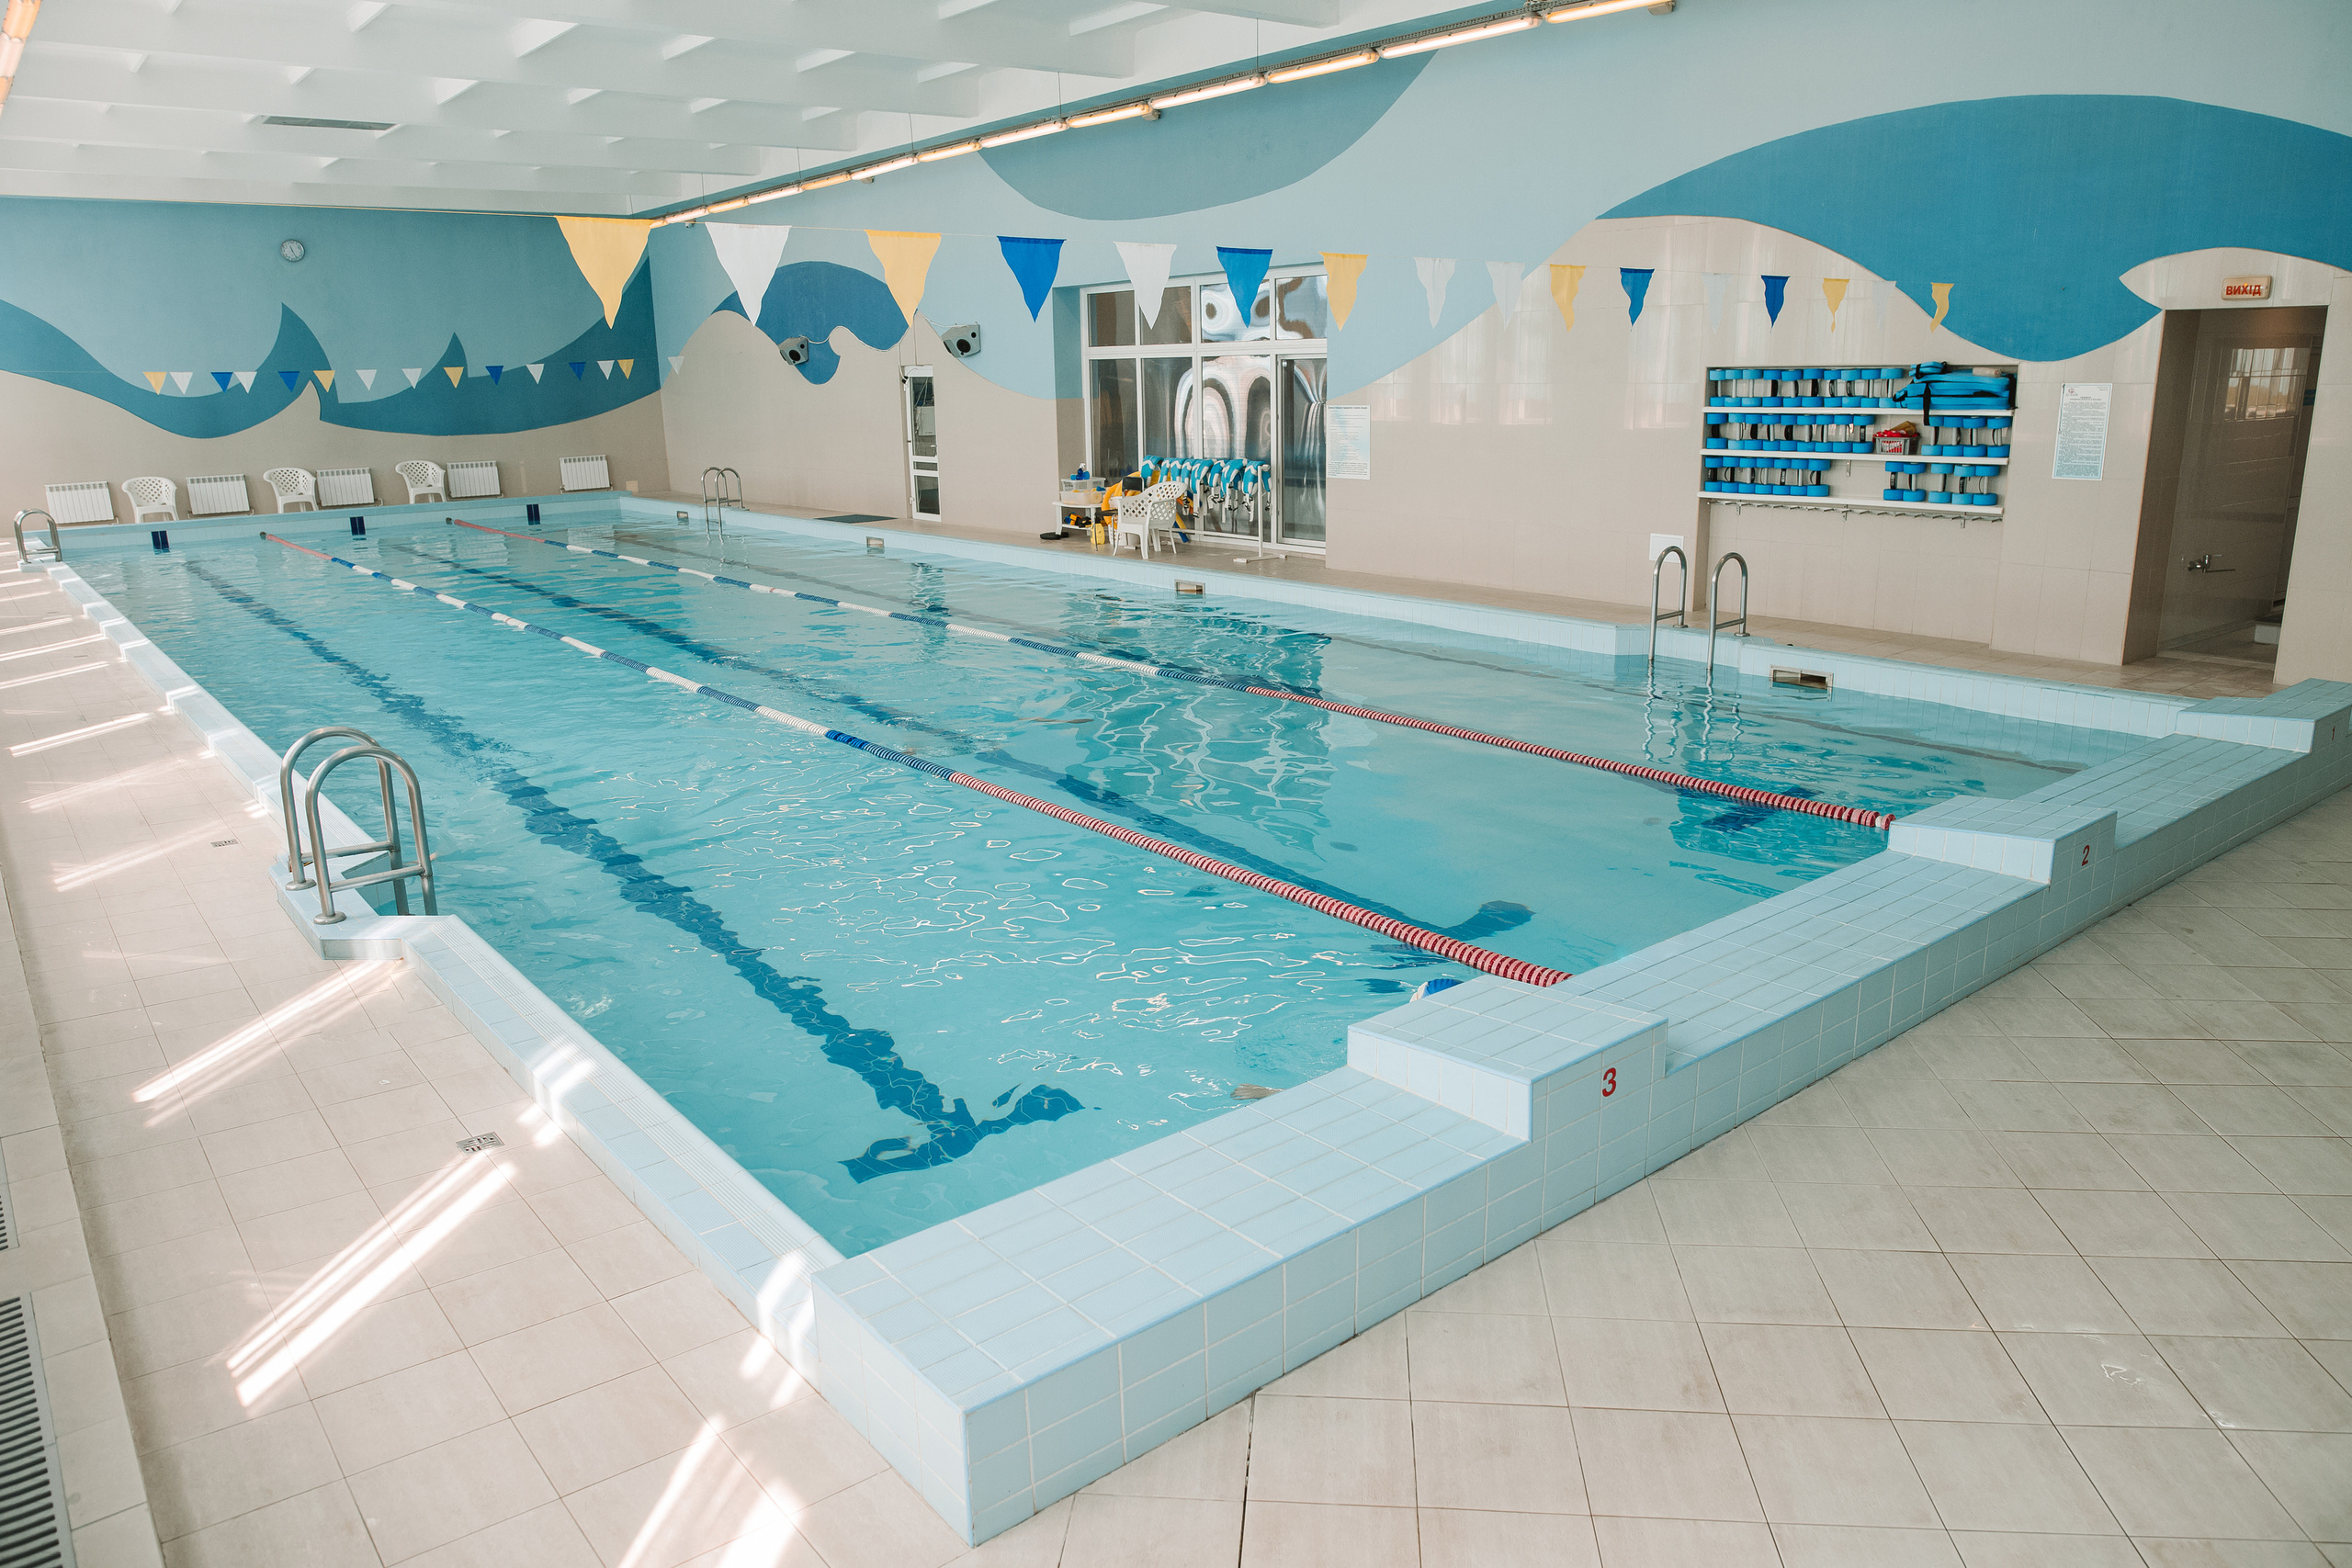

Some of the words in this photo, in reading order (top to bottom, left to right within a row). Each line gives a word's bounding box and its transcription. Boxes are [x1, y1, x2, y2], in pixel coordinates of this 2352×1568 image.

[2225, 284, 2262, 297] ВИХІД
[2081, 844, 2090, 867] 2
[1601, 1066, 1617, 1098] 3
